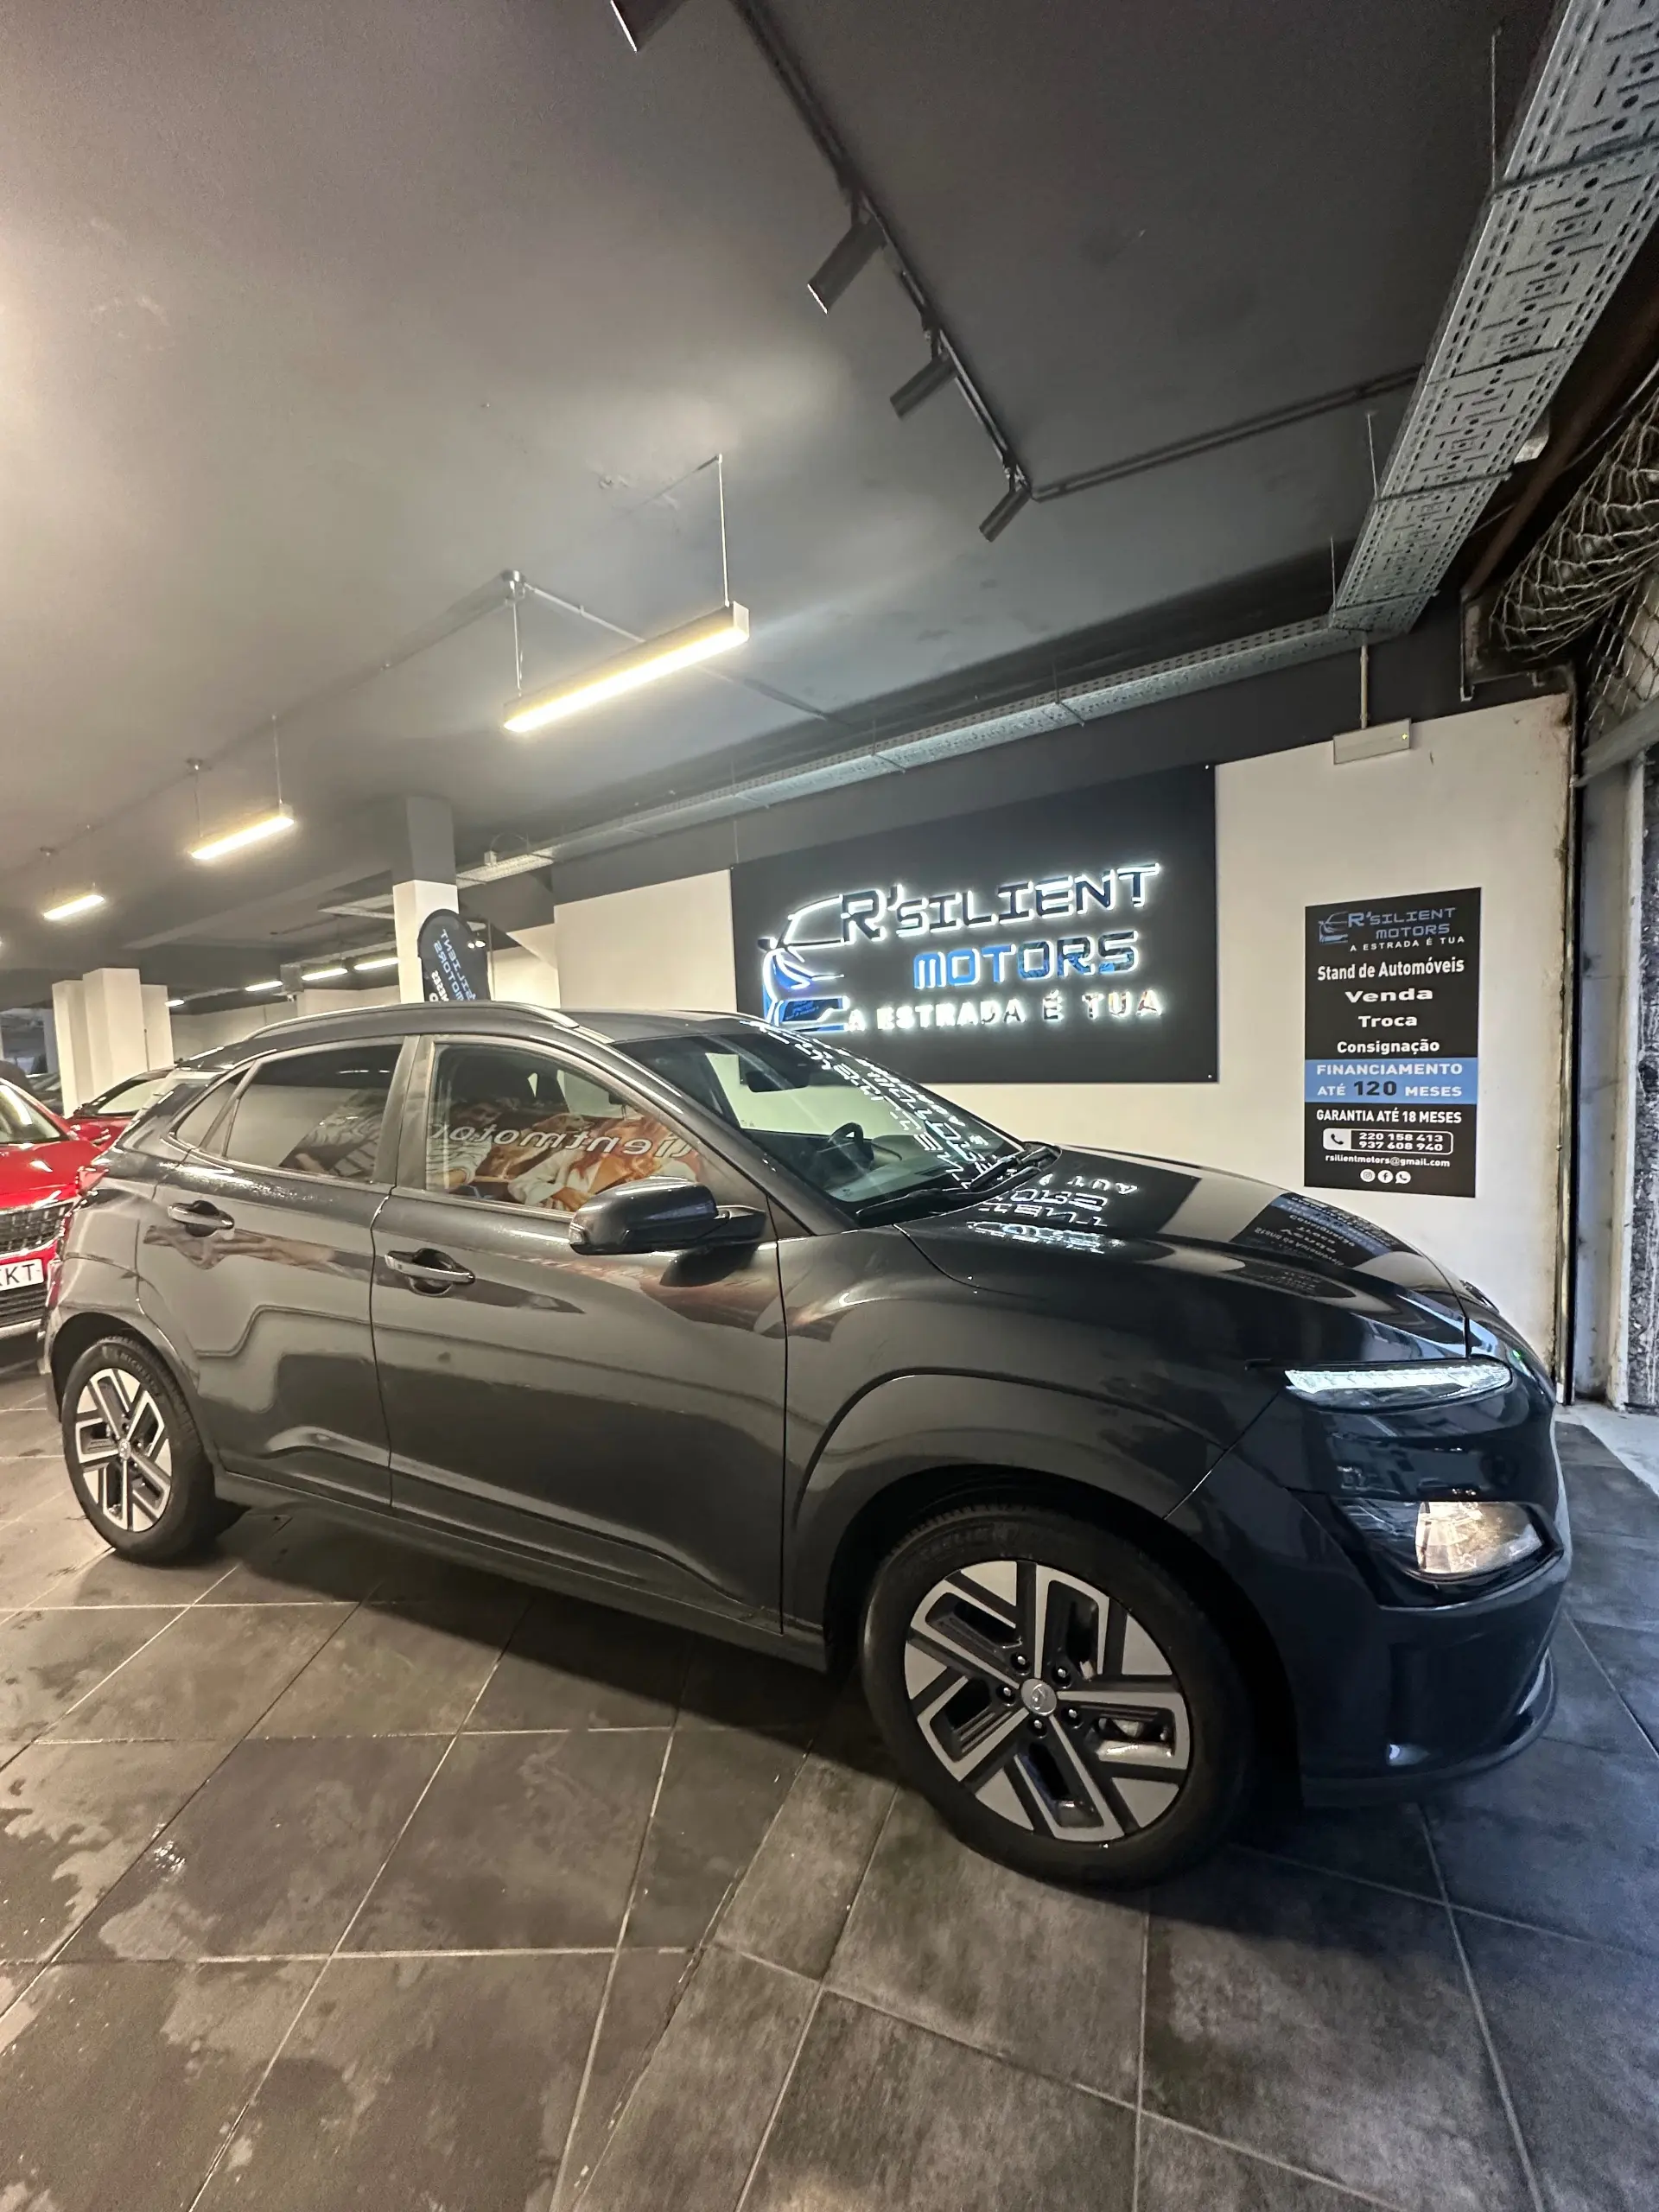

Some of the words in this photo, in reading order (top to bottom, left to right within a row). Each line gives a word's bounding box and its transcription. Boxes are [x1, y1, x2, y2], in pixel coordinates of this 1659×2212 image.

[839, 862, 1160, 946] R'SILIENT
[1348, 907, 1457, 928] R'SILIENT
[1376, 923, 1451, 939] MOTORS
[1363, 939, 1420, 950] ESTRADA
[1440, 936, 1465, 944] TUA
[912, 930, 1139, 989] MOTORS
[1318, 963, 1356, 981] Stand
[1358, 963, 1375, 978] de
[1378, 957, 1465, 978] Automóveis
[1344, 988, 1433, 1003] Venda
[846, 1007, 870, 1033] A
[876, 998, 1026, 1032] ESTRADA
[1041, 989, 1063, 1021] É
[1084, 989, 1163, 1020] TUA
[1357, 1015, 1418, 1027] Troca
[1337, 1039, 1440, 1055] Consignação
[1316, 1064, 1463, 1075] FINANCIAMENTO
[1317, 1084, 1345, 1096] ATÉ
[1353, 1081, 1397, 1096] 120
[1405, 1085, 1462, 1096] MESES
[1316, 1109, 1375, 1122] GARANTIA
[1376, 1108, 1400, 1122] ATÉ
[1402, 1111, 1416, 1122] 18
[1419, 1111, 1462, 1123] MESES
[1358, 1141, 1384, 1149] 937
[1416, 1134, 1444, 1142] 413
[1325, 1154, 1451, 1167] rsilientmotors@gmail.com
[0, 1263, 35, 1286] KT
